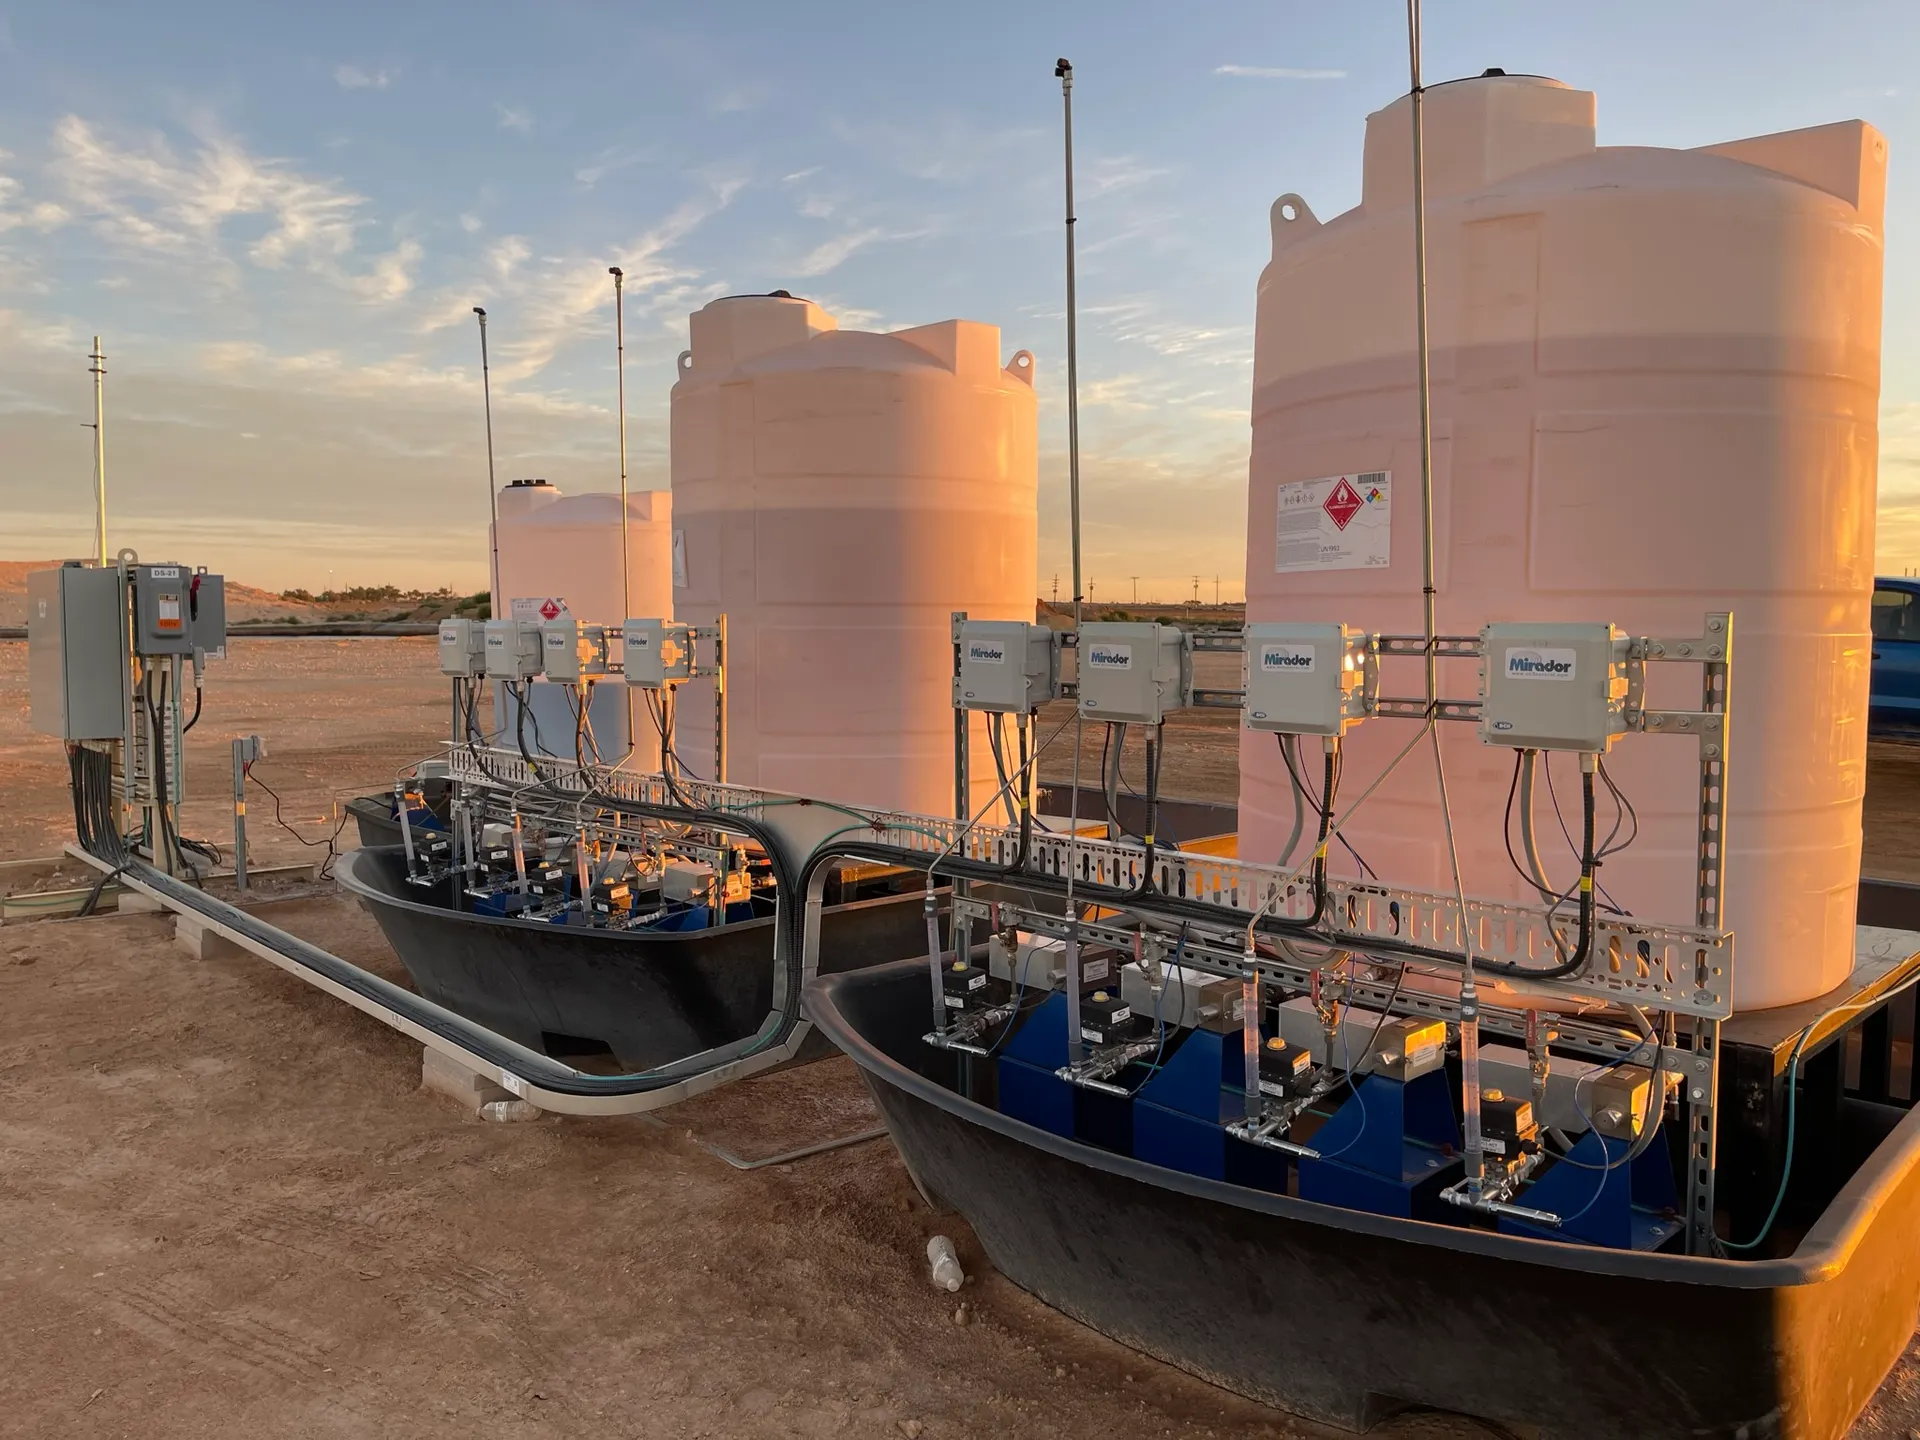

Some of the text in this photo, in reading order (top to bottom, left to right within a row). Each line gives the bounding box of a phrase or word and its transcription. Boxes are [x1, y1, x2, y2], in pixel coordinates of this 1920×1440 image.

[970, 647, 1003, 659] Mirador
[1091, 652, 1129, 664] Mirador
[1264, 653, 1312, 666] Mirador
[1509, 657, 1571, 672] Mirador
